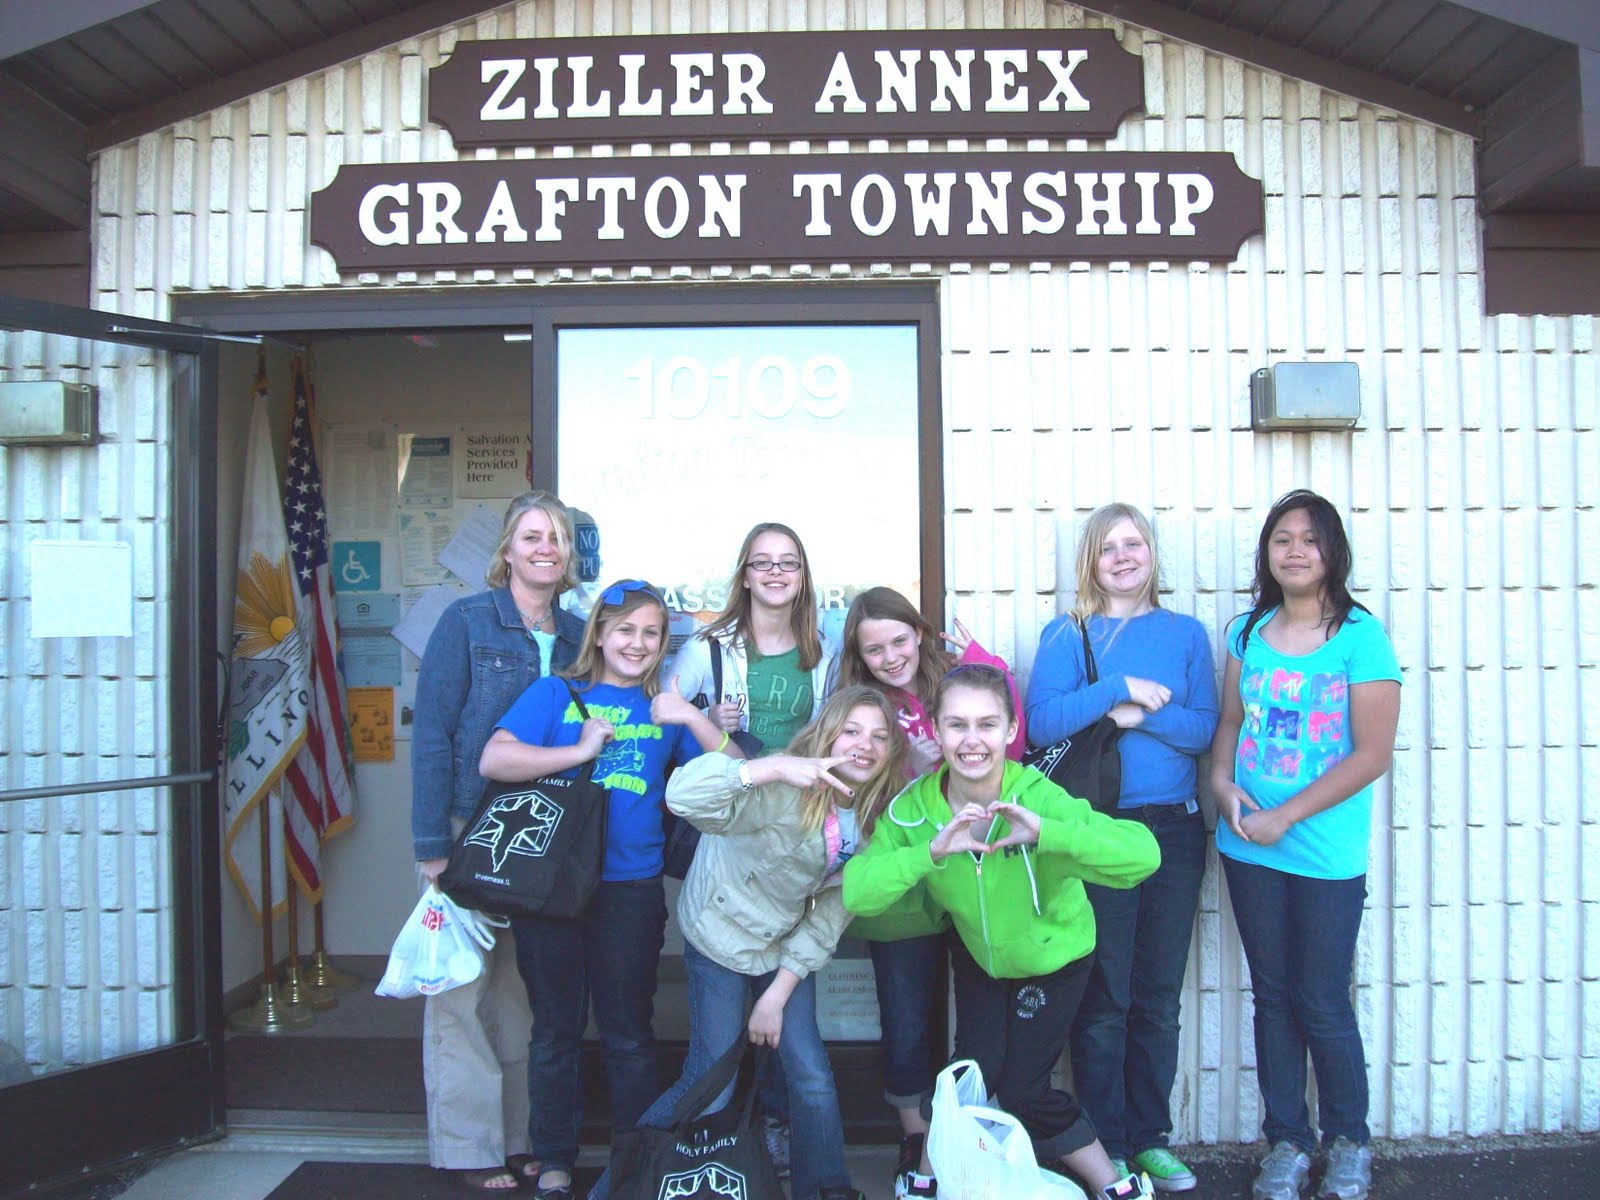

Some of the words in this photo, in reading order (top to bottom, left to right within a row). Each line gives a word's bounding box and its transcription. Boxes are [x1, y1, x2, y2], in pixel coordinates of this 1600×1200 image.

[480, 52, 774, 121] ZILLER
[814, 49, 1090, 113] ANNEX
[358, 174, 747, 246] GRAFTON
[793, 171, 1214, 237] TOWNSHIP
[623, 354, 850, 420] 10109
[466, 433, 520, 446] Salvation
[466, 446, 516, 458] Services
[466, 459, 519, 470] Provided
[467, 473, 494, 482] Here
[579, 530, 599, 549] NO
[1270, 668, 1307, 703] MTV
[537, 777, 574, 788] FAMILY
[676, 1142, 701, 1157] HOLY
[703, 1137, 738, 1154] FAMILY
